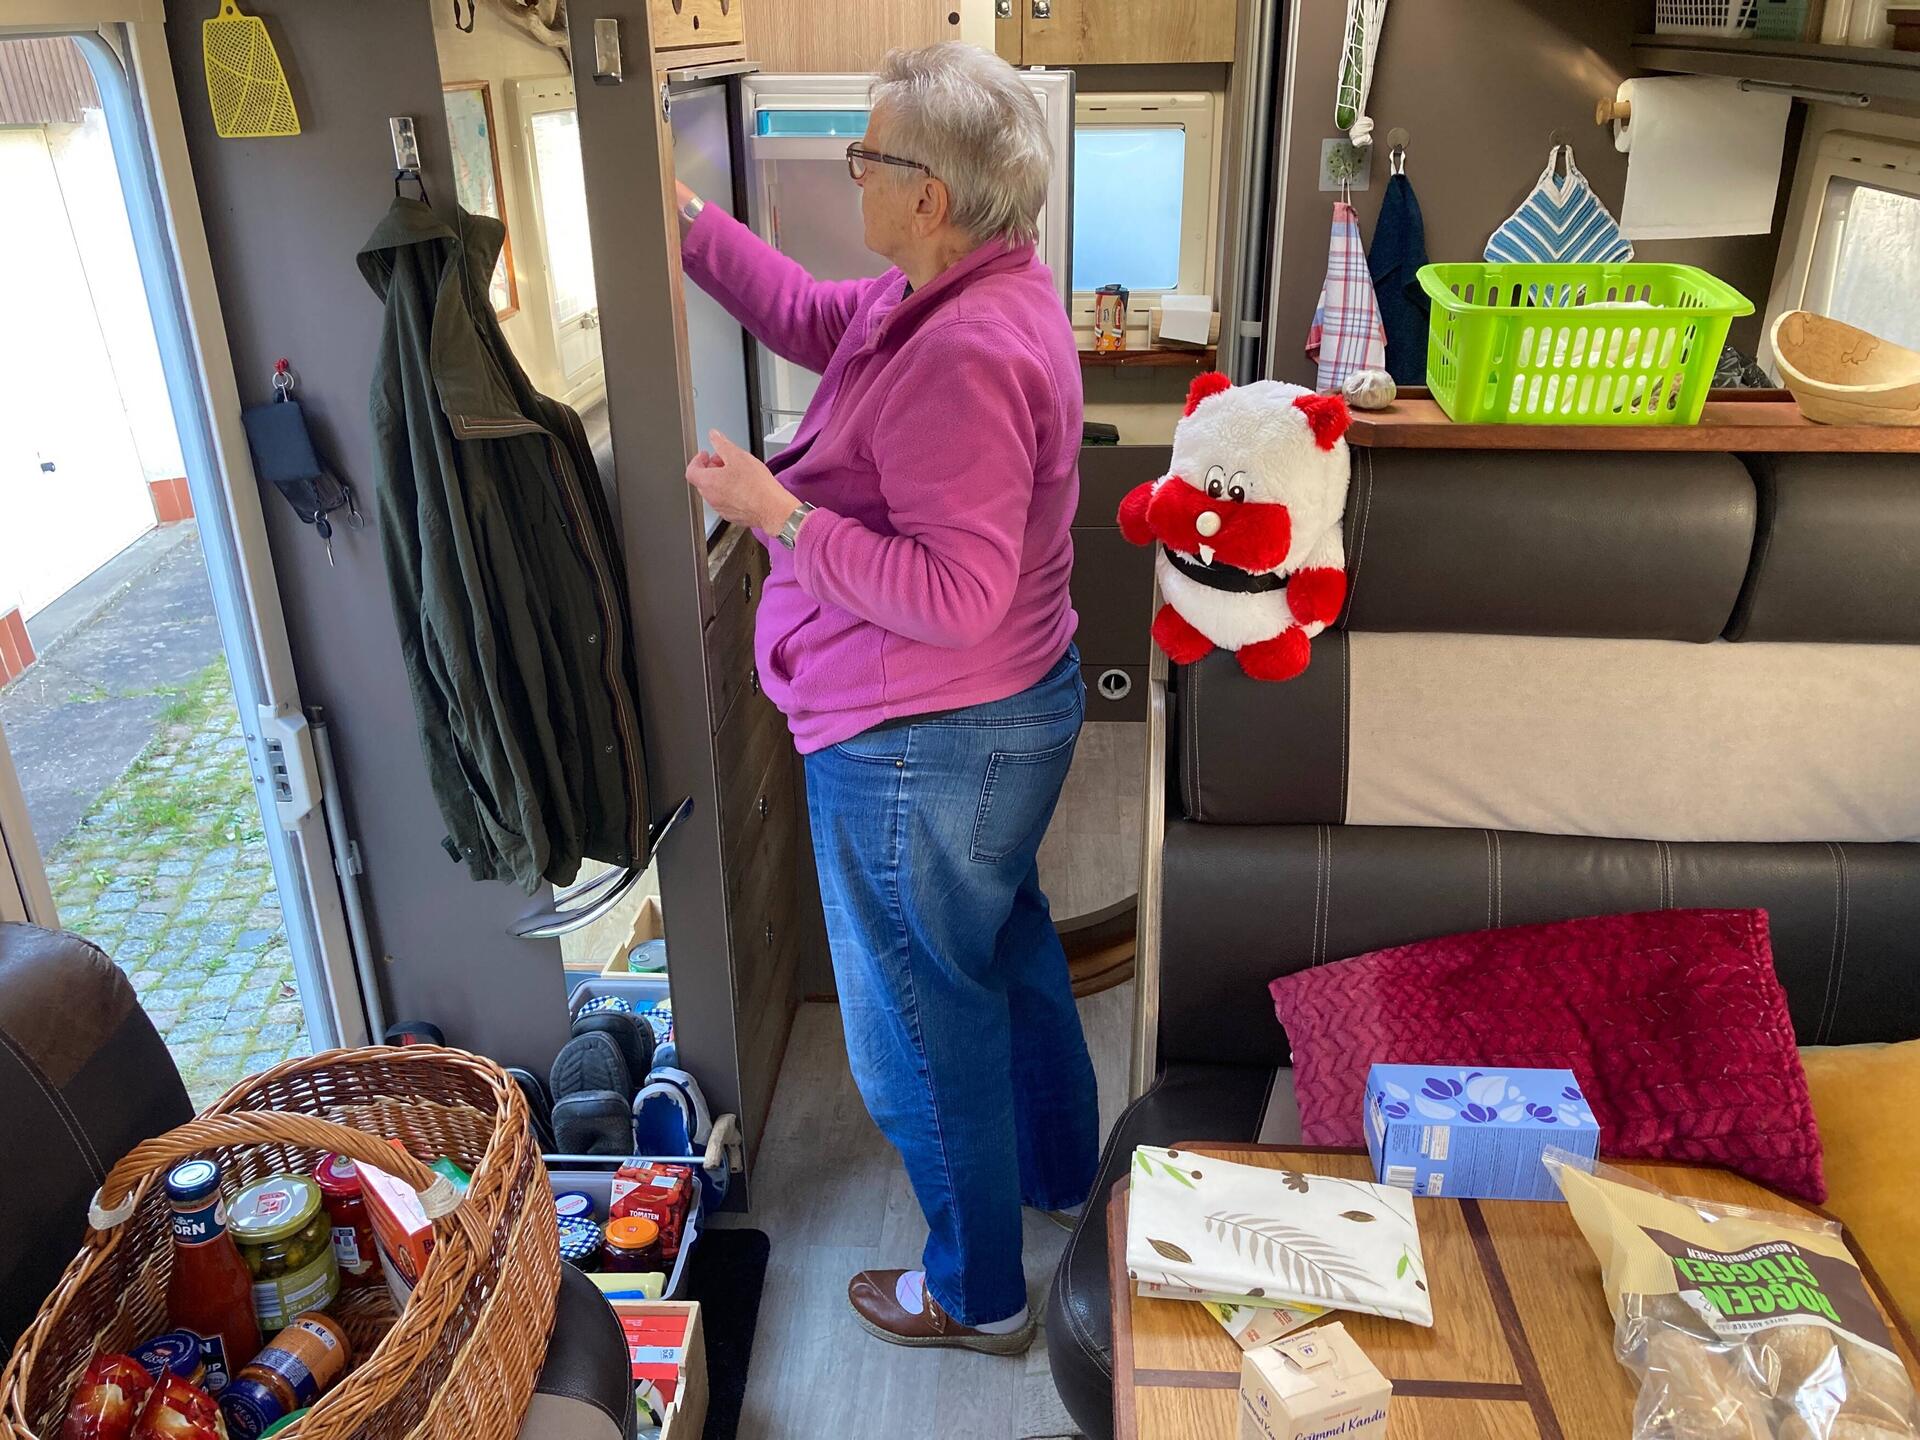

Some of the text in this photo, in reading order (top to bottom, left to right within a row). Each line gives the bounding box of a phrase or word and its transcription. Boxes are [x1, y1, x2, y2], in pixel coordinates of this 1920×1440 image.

[630, 1210, 659, 1220] TOMATEN
[1687, 1243, 1794, 1263] ROGGENBRÖTCHEN
[1699, 1282, 1841, 1323] ROGGEN
[1732, 1323, 1747, 1331] DER
[1748, 1321, 1763, 1329] AUS
[1348, 1408, 1386, 1432] Kandis
